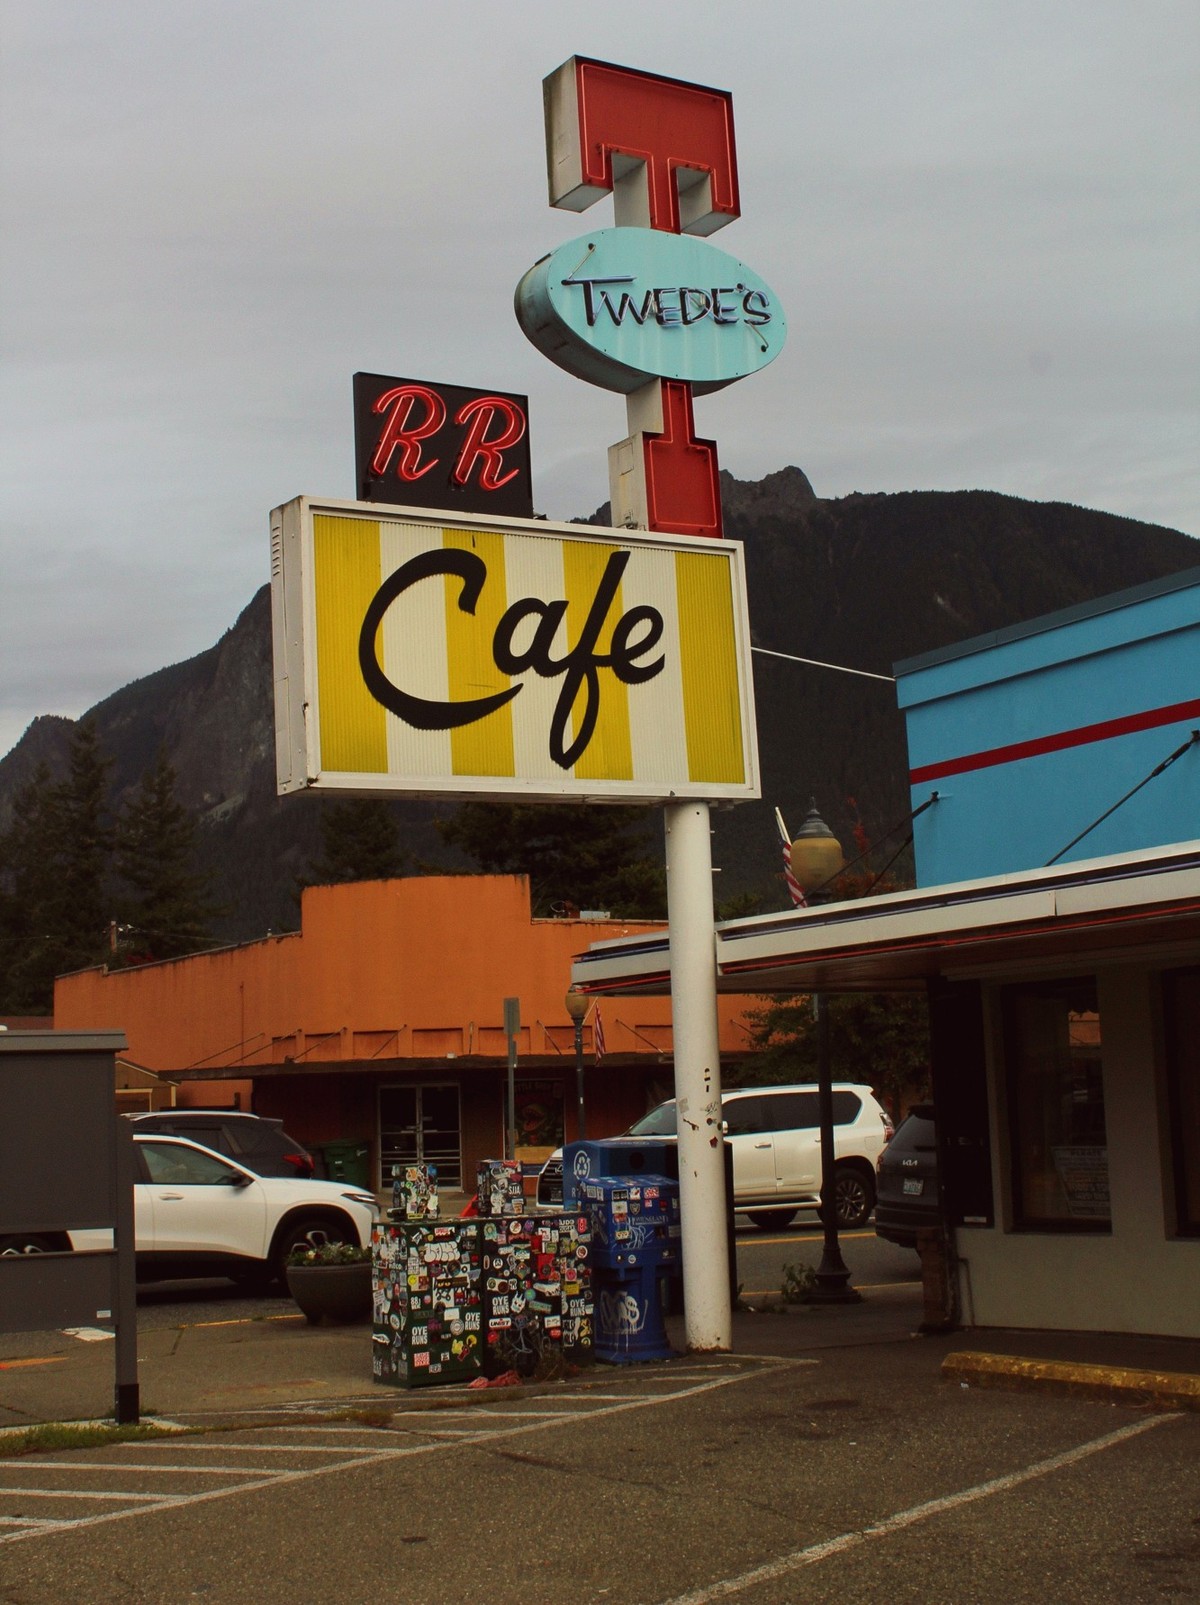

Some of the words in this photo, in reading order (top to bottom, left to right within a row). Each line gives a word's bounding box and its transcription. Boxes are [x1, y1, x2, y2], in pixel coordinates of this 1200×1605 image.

[561, 274, 772, 327] TWEDE'S
[358, 547, 665, 769] Cafe
[492, 1295, 509, 1305] OYE
[569, 1298, 585, 1308] OYE
[465, 1312, 480, 1321] OYE
[411, 1326, 428, 1335] OYE
